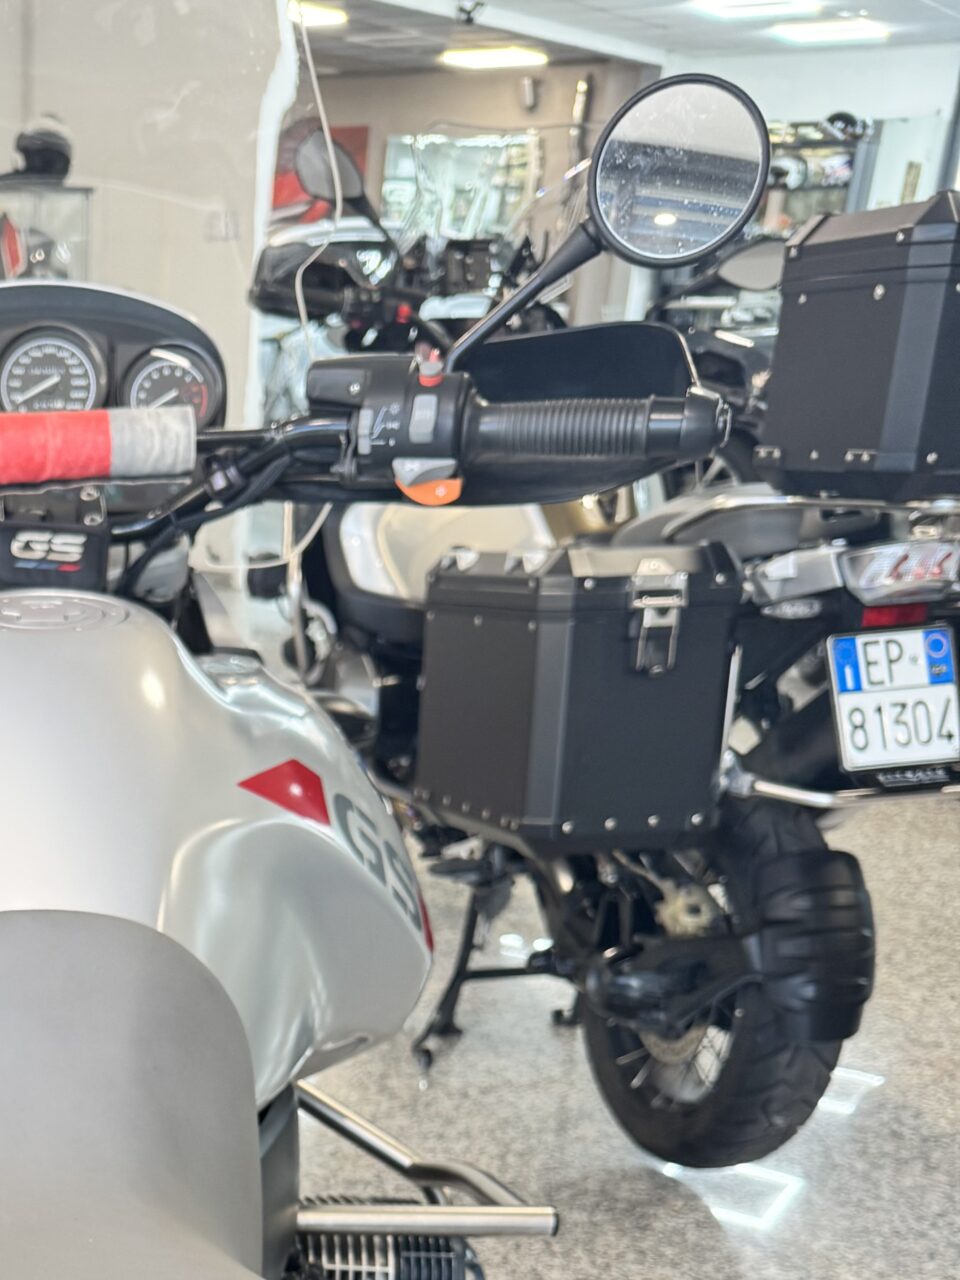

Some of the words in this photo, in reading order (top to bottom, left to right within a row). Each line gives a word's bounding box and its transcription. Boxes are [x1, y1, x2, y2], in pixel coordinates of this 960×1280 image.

[10, 531, 87, 561] GS
[862, 639, 903, 685] EP
[848, 697, 954, 751] 81304
[333, 793, 422, 932] GS
